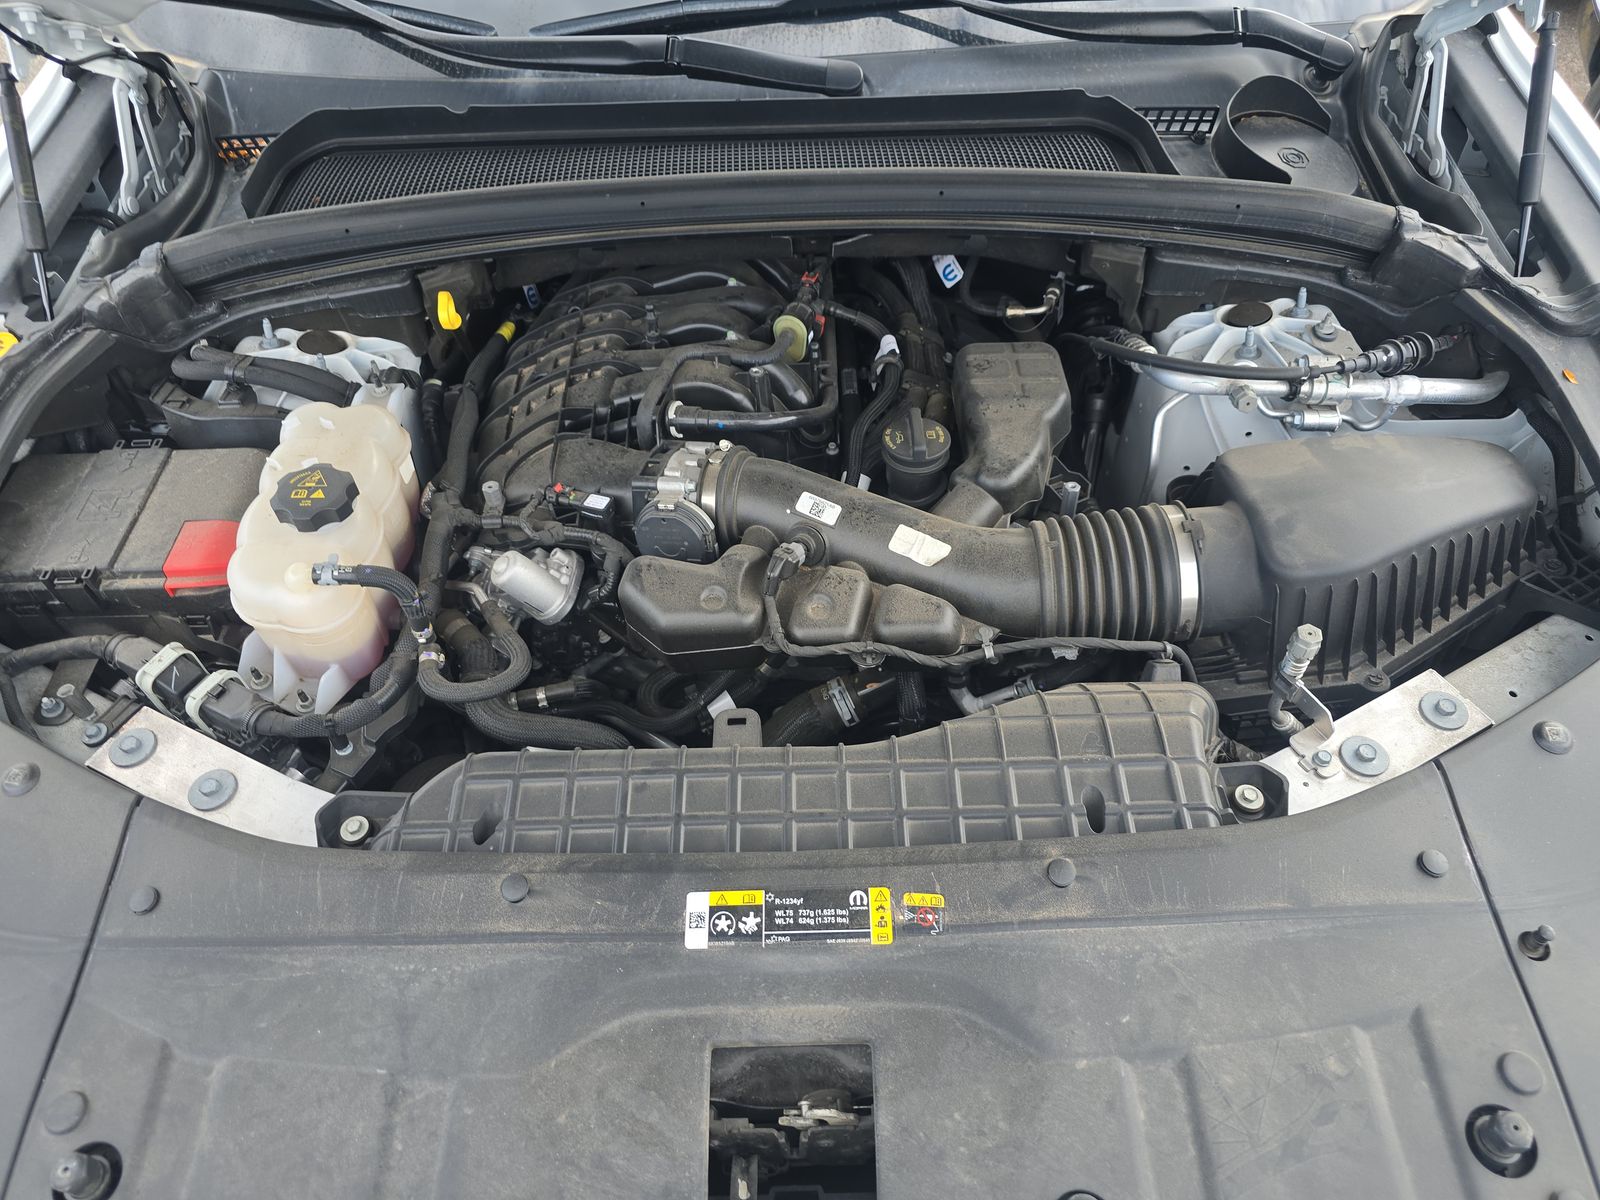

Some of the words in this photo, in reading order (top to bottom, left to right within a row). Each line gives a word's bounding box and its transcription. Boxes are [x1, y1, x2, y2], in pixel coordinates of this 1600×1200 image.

[774, 897, 804, 906] R-1234yf
[774, 909, 794, 917] WL75
[798, 909, 815, 917] 737g
[774, 917, 794, 925] WL74
